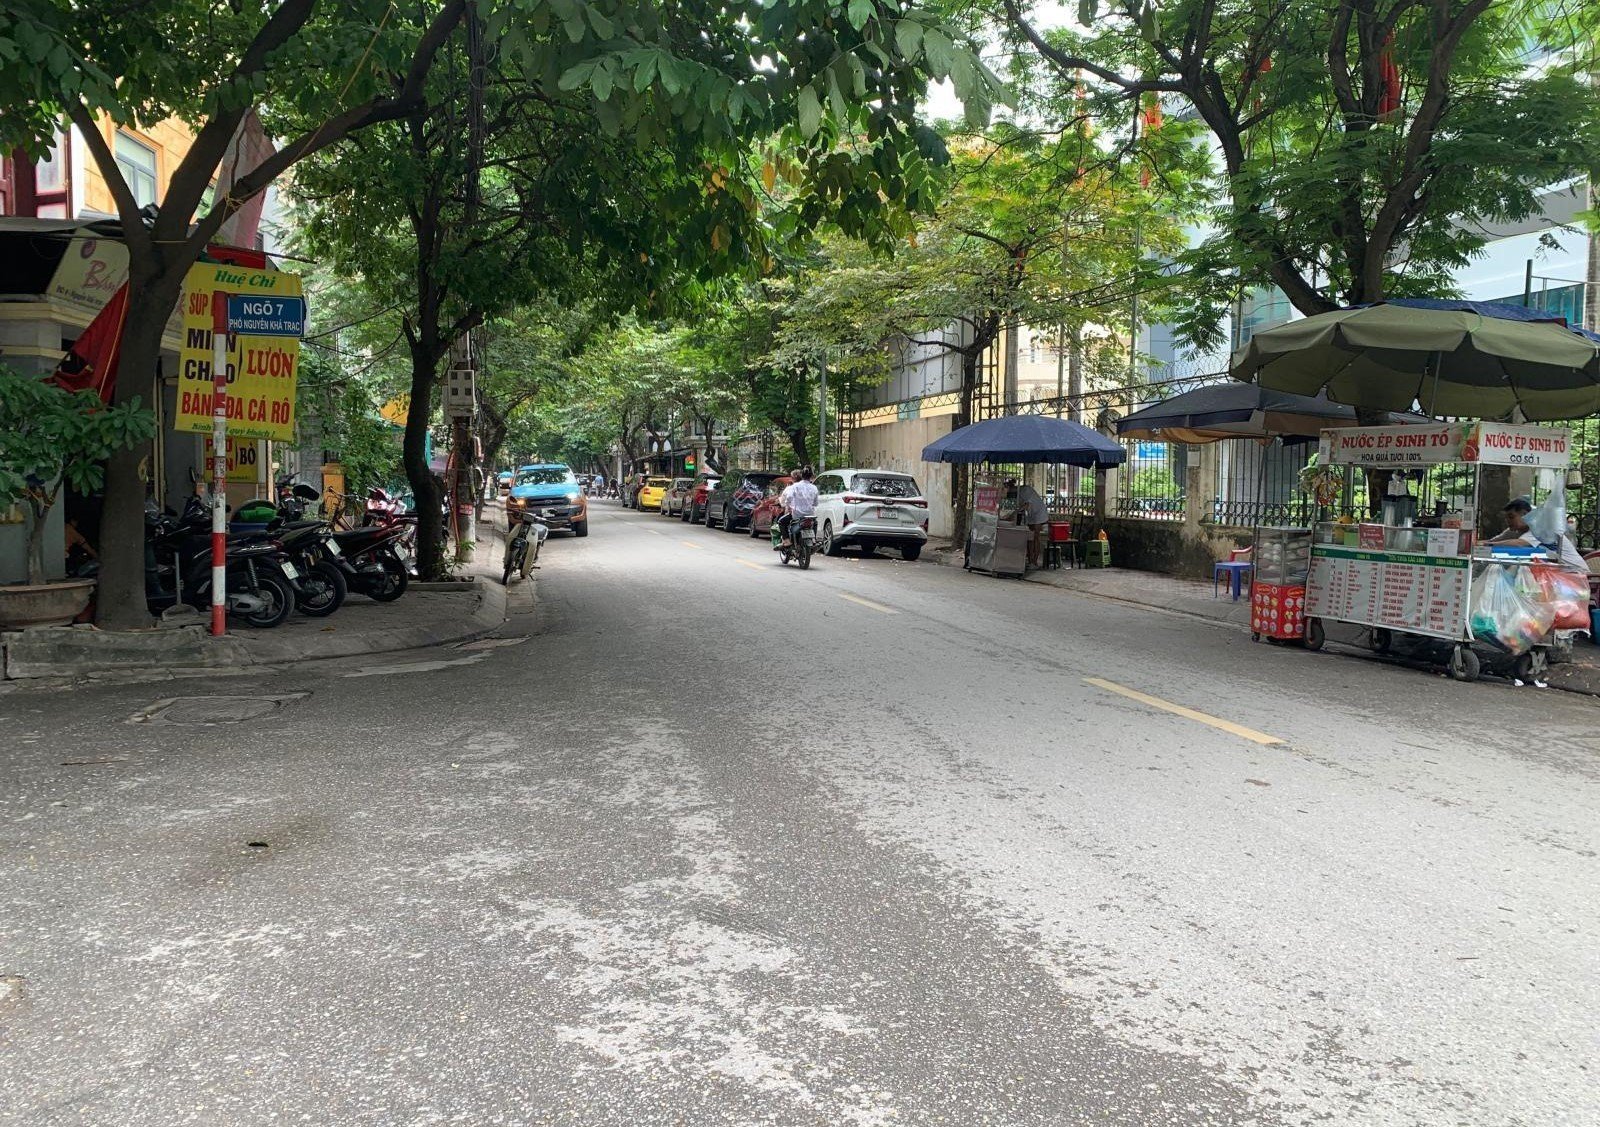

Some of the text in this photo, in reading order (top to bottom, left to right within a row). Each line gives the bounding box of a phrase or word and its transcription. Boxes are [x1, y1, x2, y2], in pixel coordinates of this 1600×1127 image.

[215, 270, 276, 288] Huệ Chi
[189, 288, 208, 316] SÚP
[243, 300, 284, 315] NGÕ 7
[229, 318, 243, 329] PHỐ
[244, 317, 269, 330] NGUYỄN
[284, 321, 300, 333] TRẠC
[187, 328, 237, 353] MIN
[185, 358, 236, 384] CHO
[246, 346, 294, 379] LƯƠN
[248, 395, 266, 422] CÁ
[271, 397, 290, 424] RÔ
[1377, 433, 1392, 448] ÉP
[1395, 434, 1427, 448] SINH
[1431, 428, 1450, 446] TỐ
[1485, 431, 1566, 453] NƯỚC ÉP SINH TỐ
[206, 458, 233, 471] BN
[1361, 453, 1374, 461] HOA
[1406, 453, 1422, 461] 100%
[1524, 453, 1535, 464] SỞ
[1536, 456, 1540, 465] 1
